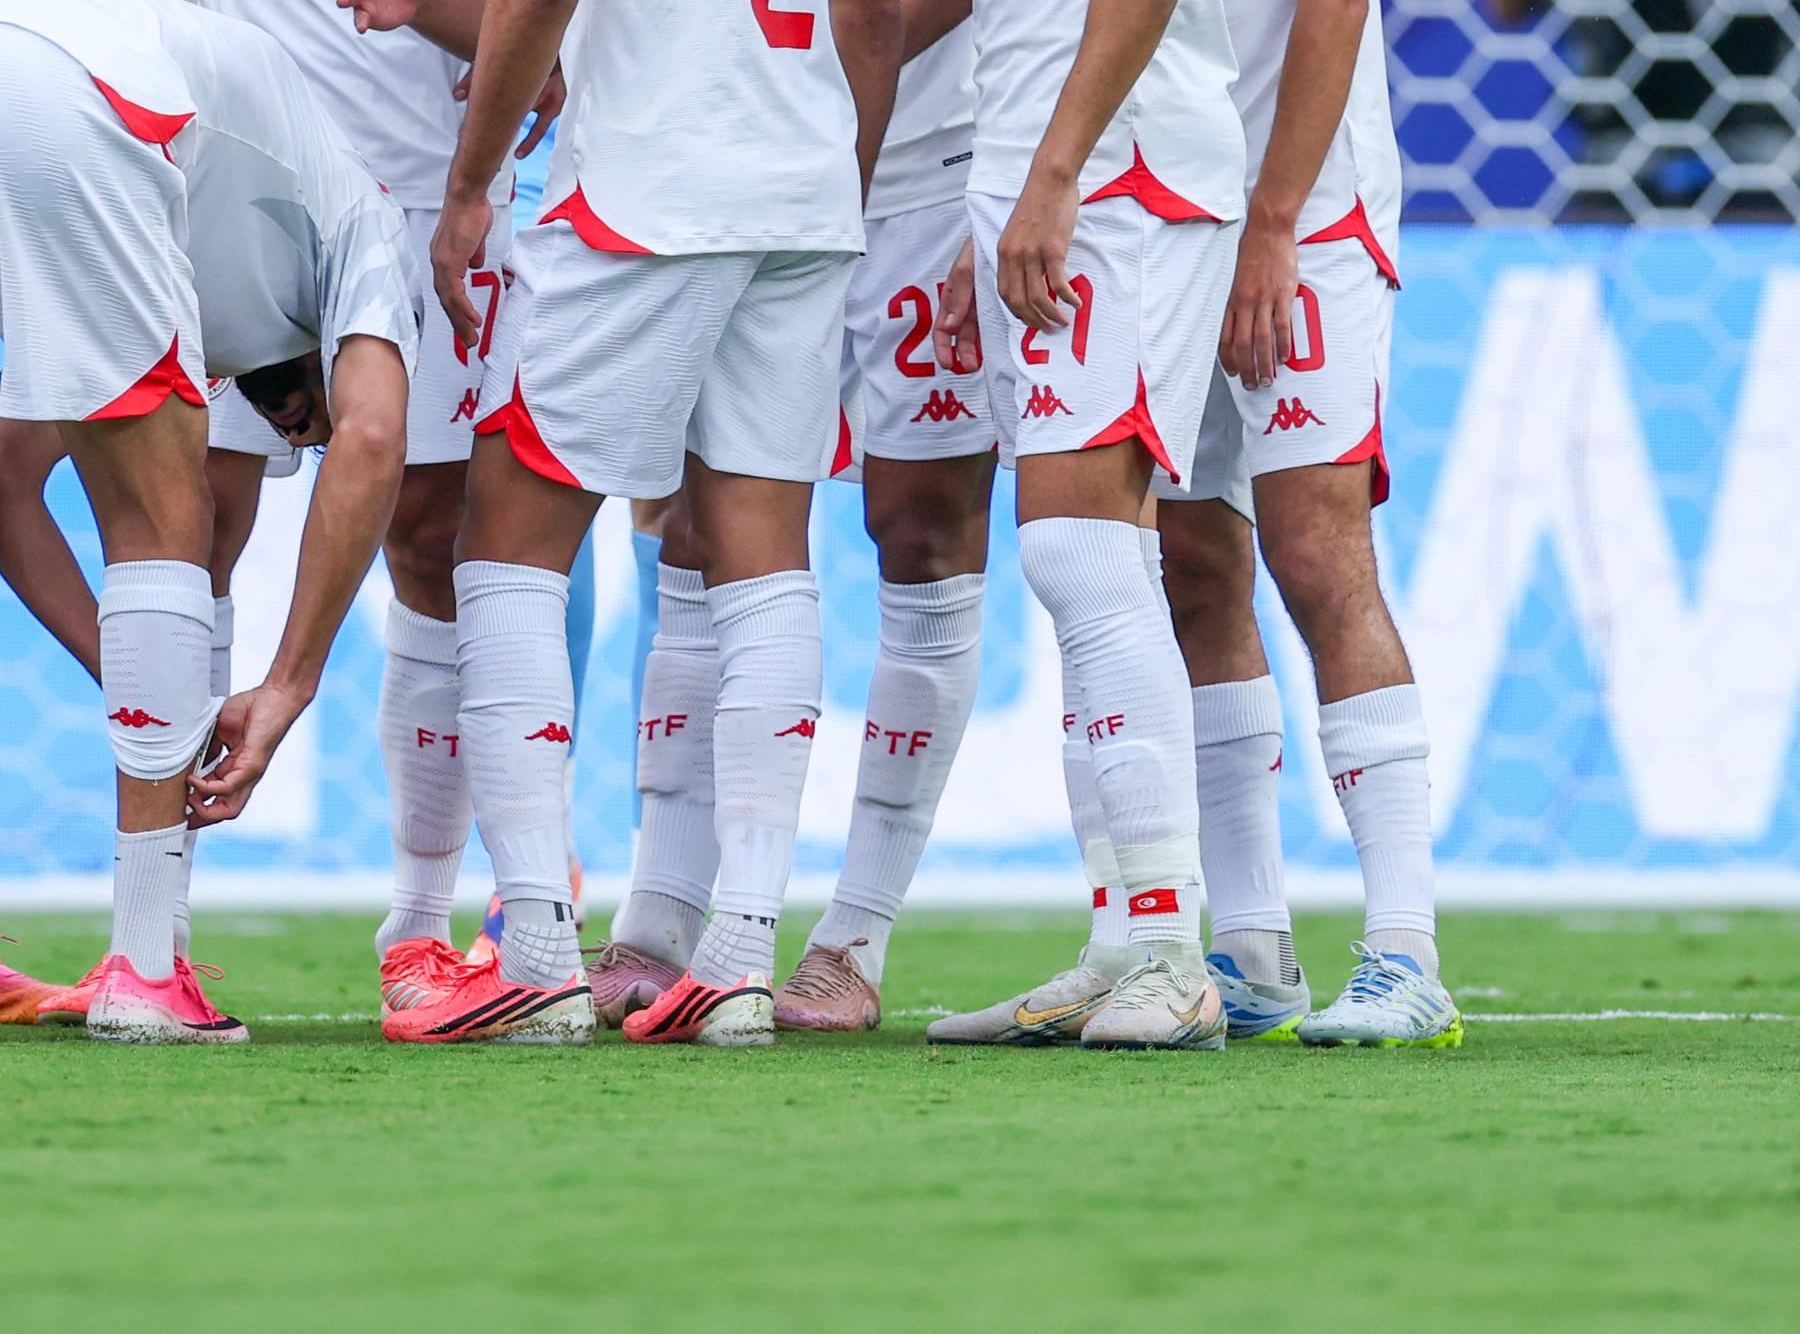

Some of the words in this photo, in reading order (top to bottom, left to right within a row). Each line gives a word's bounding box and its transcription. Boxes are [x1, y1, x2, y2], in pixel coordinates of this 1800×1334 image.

[888, 282, 983, 378] 2
[1272, 283, 1325, 378] 0
[417, 727, 459, 757] FT
[865, 720, 932, 756] FTF
